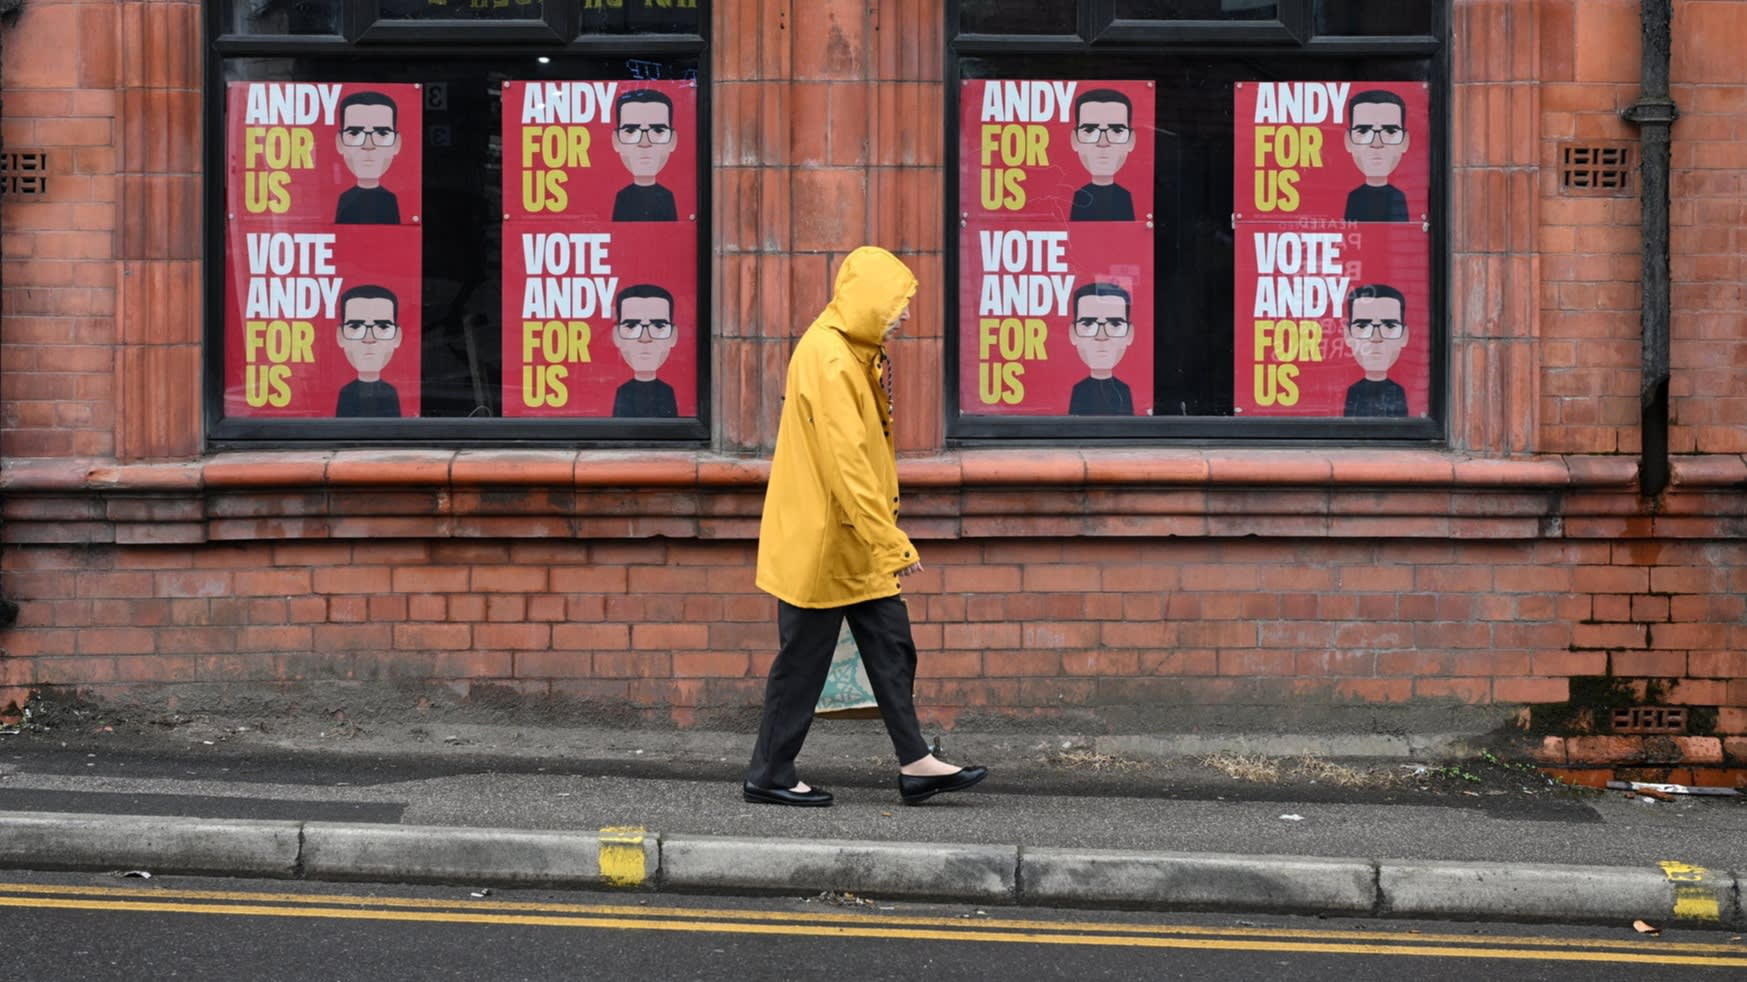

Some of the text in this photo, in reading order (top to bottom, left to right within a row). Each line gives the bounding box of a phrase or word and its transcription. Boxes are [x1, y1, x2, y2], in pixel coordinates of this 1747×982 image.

[244, 82, 343, 126] ANDY
[521, 81, 618, 124] ANDY
[980, 80, 1078, 123] ANDY
[1254, 81, 1351, 124] ANDY
[245, 126, 315, 170] FOR
[522, 125, 591, 169] FOR
[981, 123, 1050, 167] FOR
[1254, 125, 1323, 168] FOR
[245, 170, 291, 214] US
[522, 169, 568, 213] US
[980, 167, 1027, 211] US
[1254, 168, 1300, 212] US
[246, 231, 336, 276] VOTE
[522, 232, 612, 276] VOTE
[979, 229, 1069, 273] VOTE
[1253, 231, 1344, 276] VOTE
[245, 276, 343, 319] ANDY
[522, 276, 619, 319] ANDY
[979, 274, 1076, 317] ANDY
[1253, 275, 1351, 319] ANDY
[245, 320, 315, 364] FOR
[522, 320, 591, 364] FOR
[979, 317, 1048, 361] FOR
[1254, 319, 1323, 363] FOR
[245, 364, 292, 408] US
[522, 364, 569, 408] US
[978, 361, 1025, 405] US
[1254, 363, 1300, 407] US
